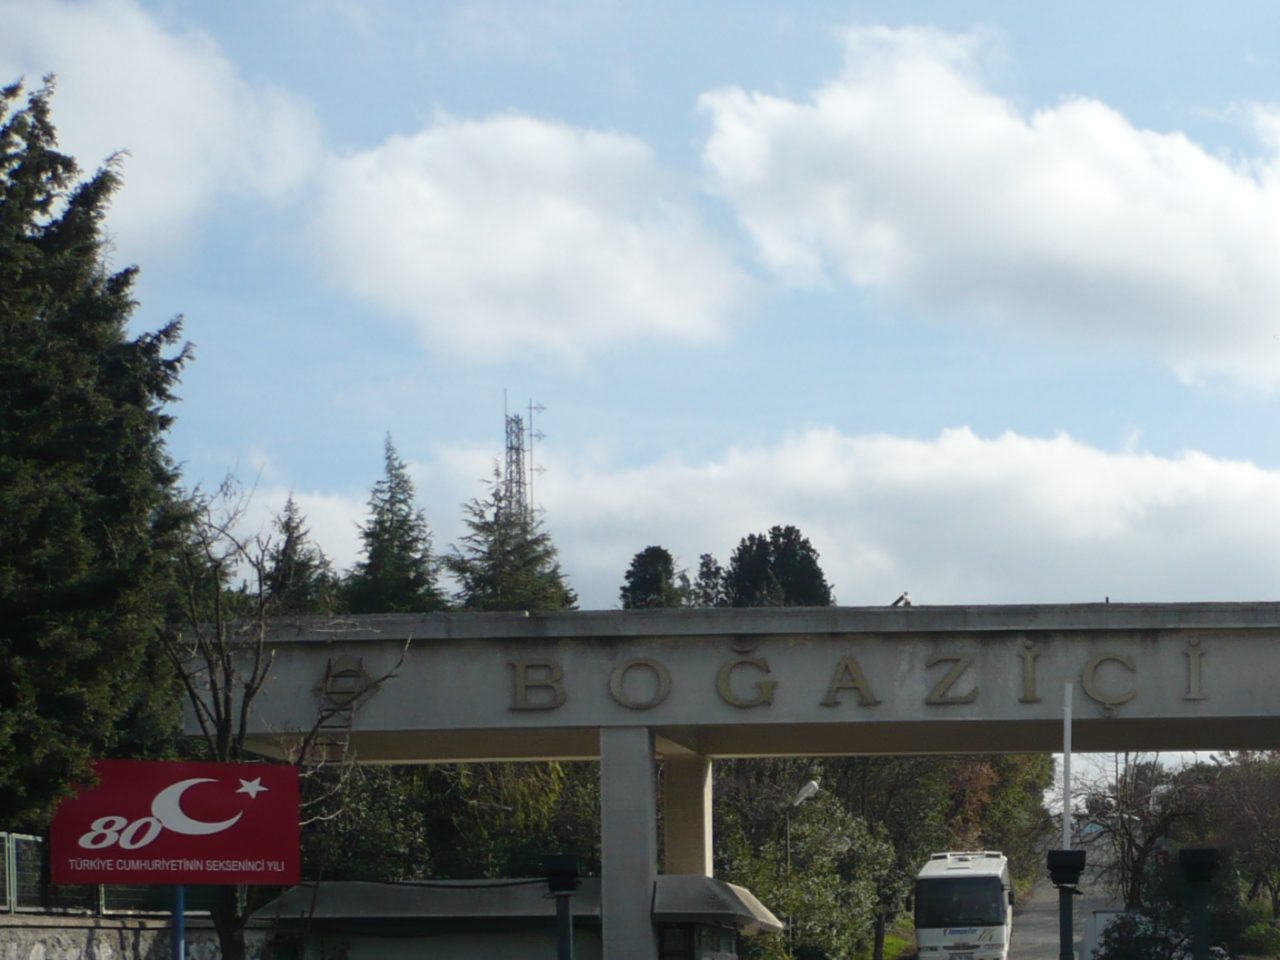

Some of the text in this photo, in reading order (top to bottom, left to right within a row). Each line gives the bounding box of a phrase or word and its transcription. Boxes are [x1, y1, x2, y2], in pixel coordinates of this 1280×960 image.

[507, 637, 1206, 718] BOĞAZİÇİ
[78, 816, 162, 850] 80
[68, 858, 285, 871] TÜRKİYE CUMHURİYETİNİN SEKSENİNCİ YILI
